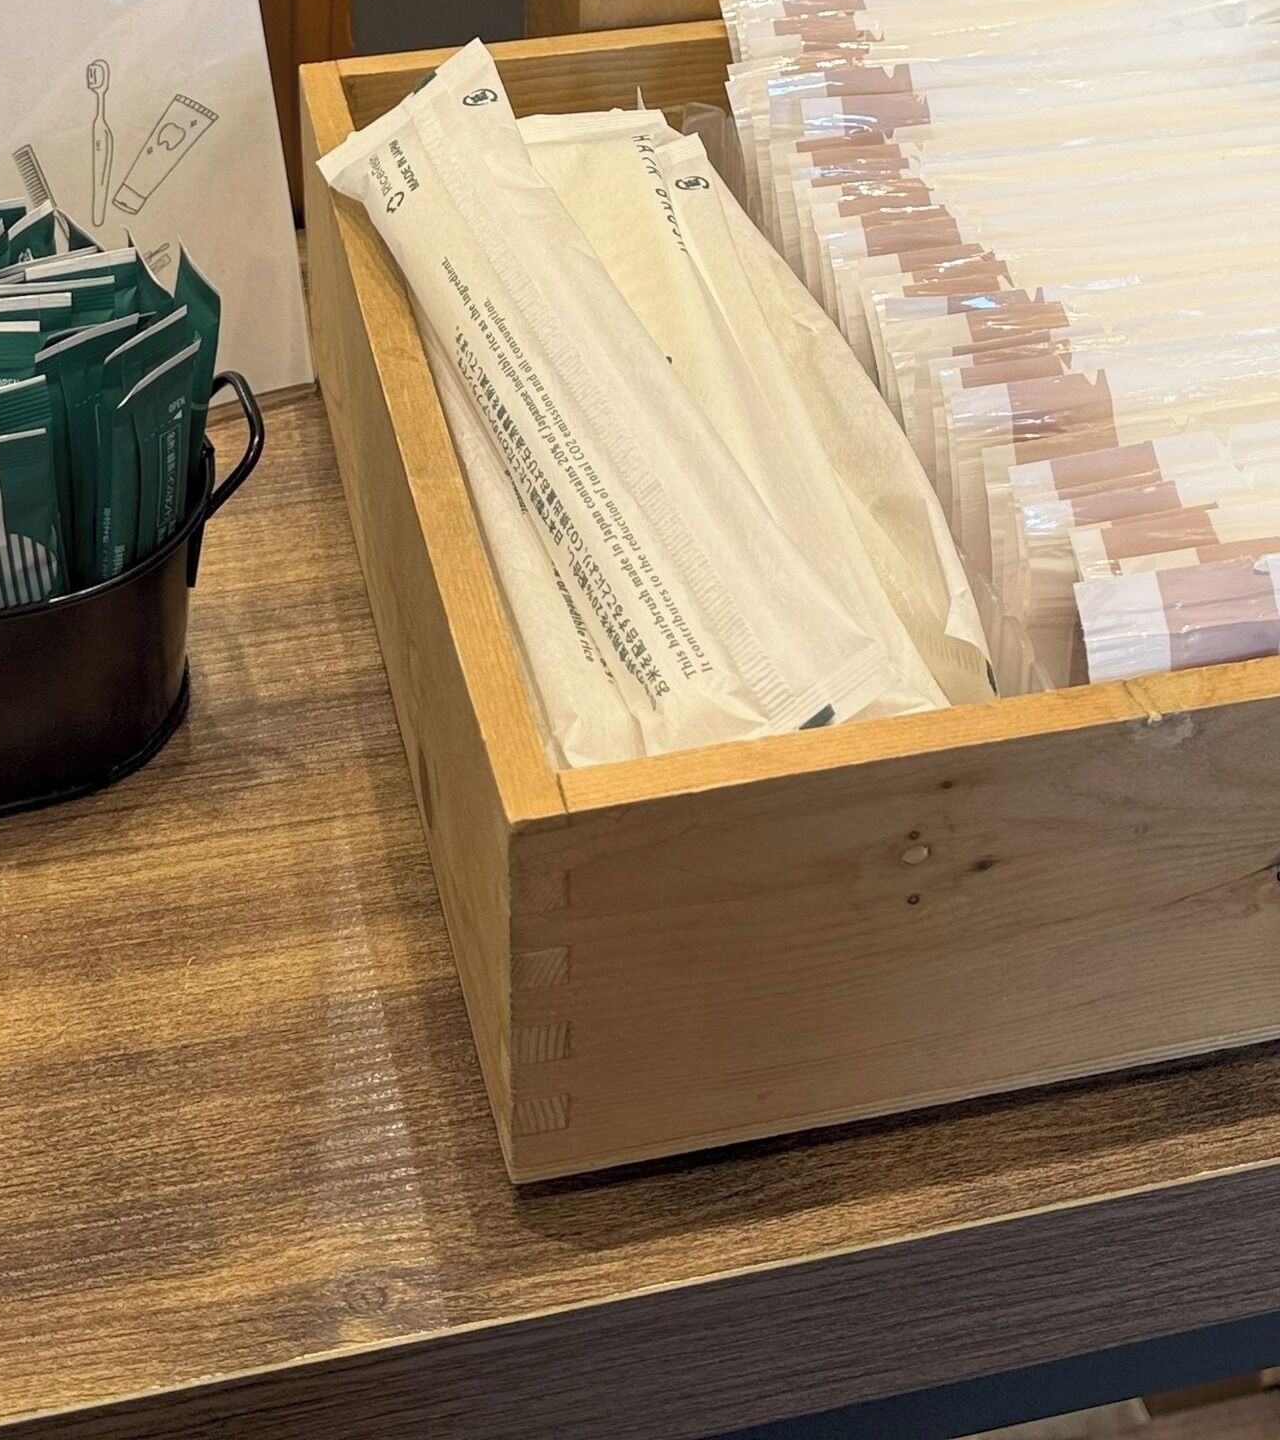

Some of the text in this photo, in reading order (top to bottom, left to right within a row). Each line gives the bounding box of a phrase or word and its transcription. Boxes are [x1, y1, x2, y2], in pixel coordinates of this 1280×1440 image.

[394, 155, 408, 168] IN
[399, 164, 421, 191] MADE
[437, 255, 698, 680] This hairbrush made in Japan contains 20% of Japanese inedible rice as the ingredient.
[479, 295, 714, 674] It contributes to the reduction of total CO2 emission and oil consumption.
[579, 635, 597, 664] rice
